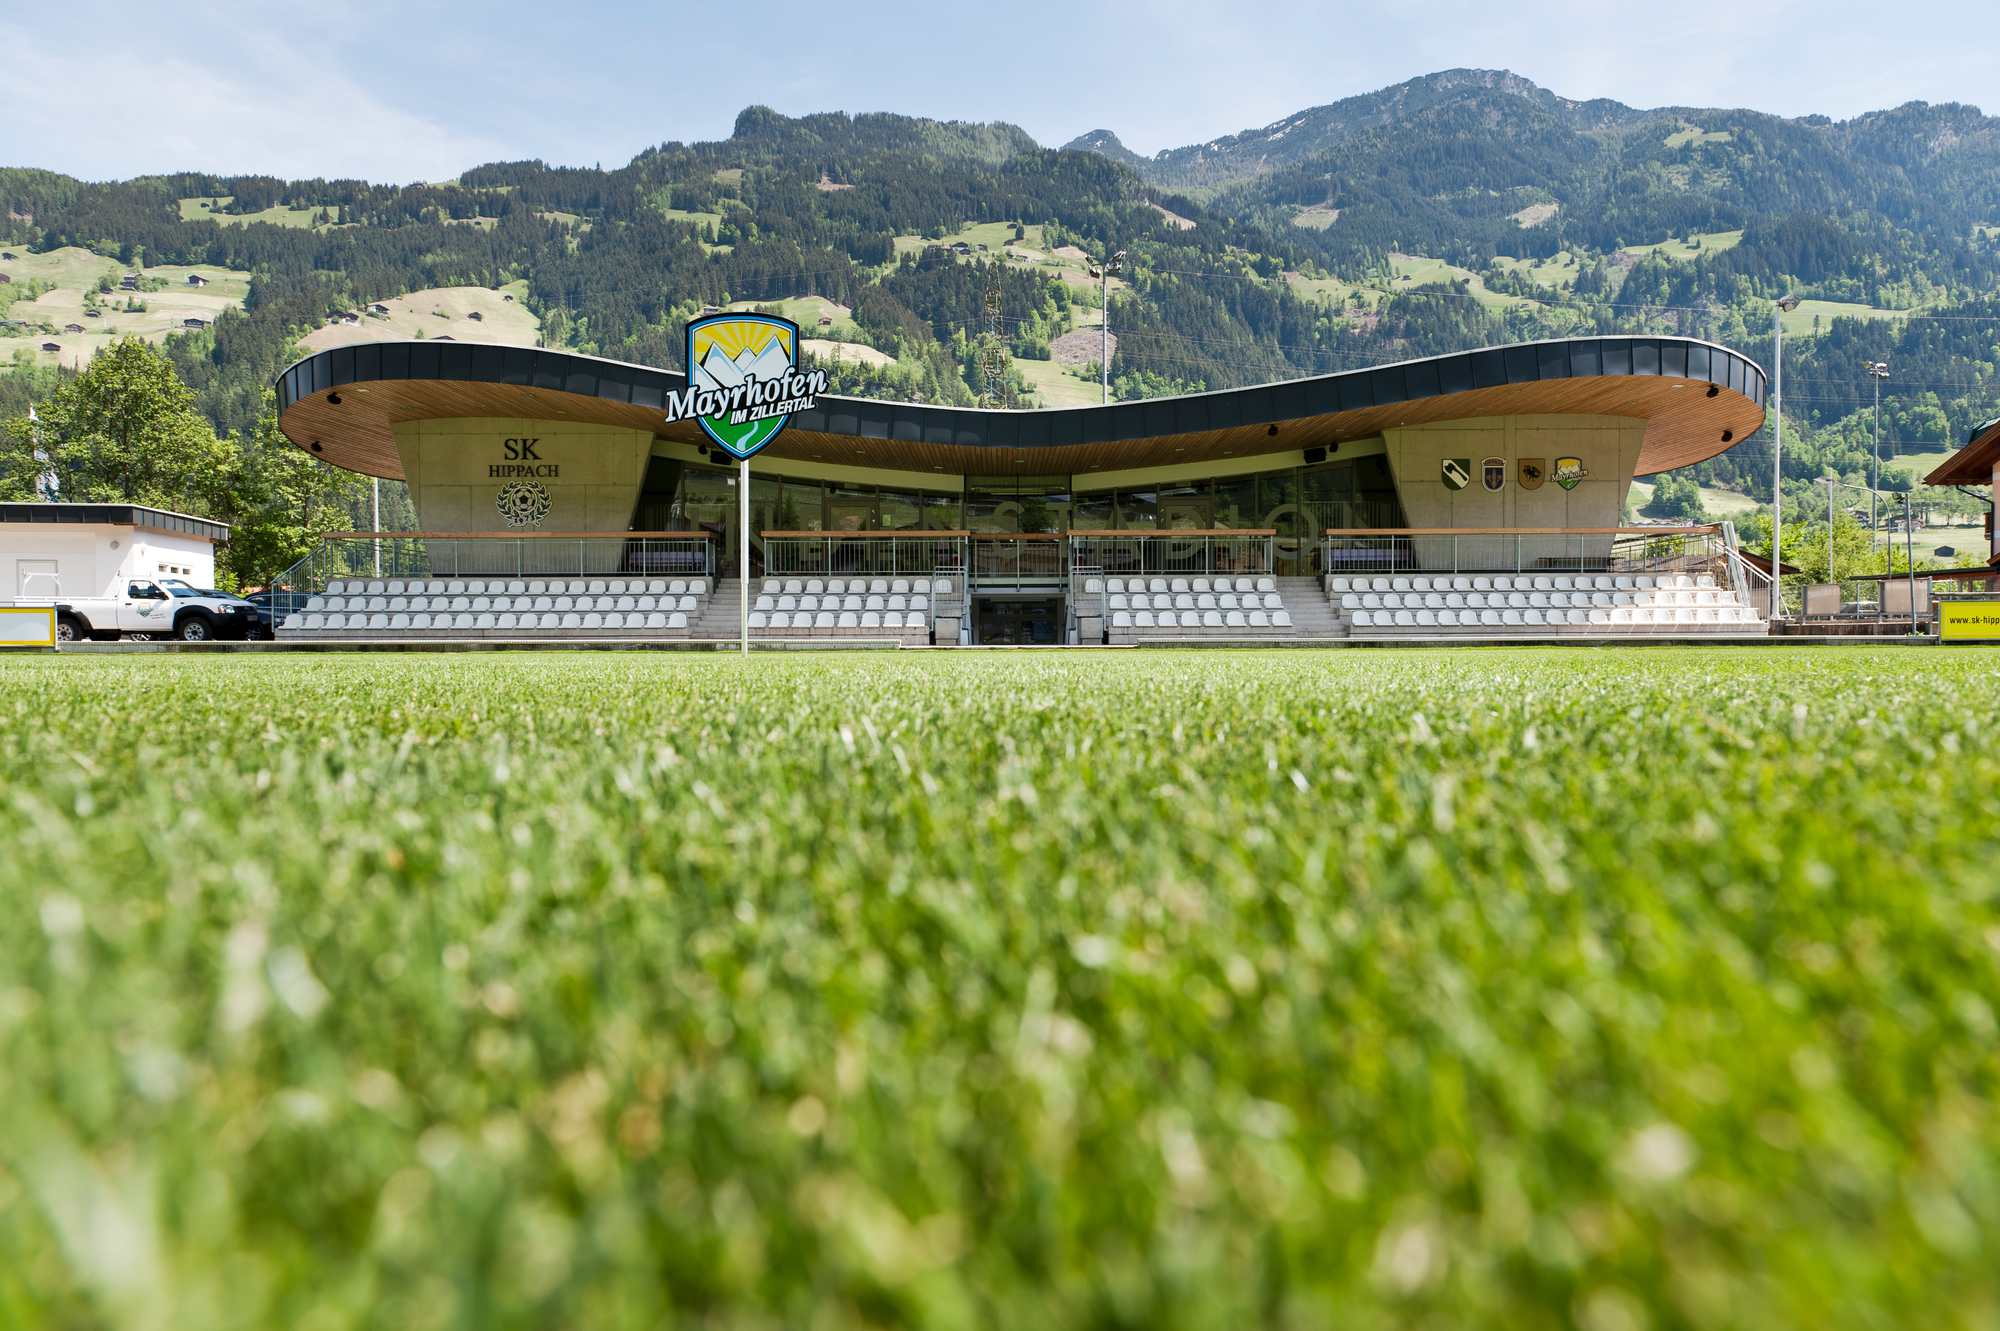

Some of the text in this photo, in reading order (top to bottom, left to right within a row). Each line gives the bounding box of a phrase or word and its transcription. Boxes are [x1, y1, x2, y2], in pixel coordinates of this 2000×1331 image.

[665, 367, 827, 422] Mayrhofen
[730, 396, 816, 425] IM ZILLERTAL
[504, 438, 542, 460] SK
[488, 465, 559, 477] HIPPACH
[1551, 469, 1589, 482] Mayrhofen
